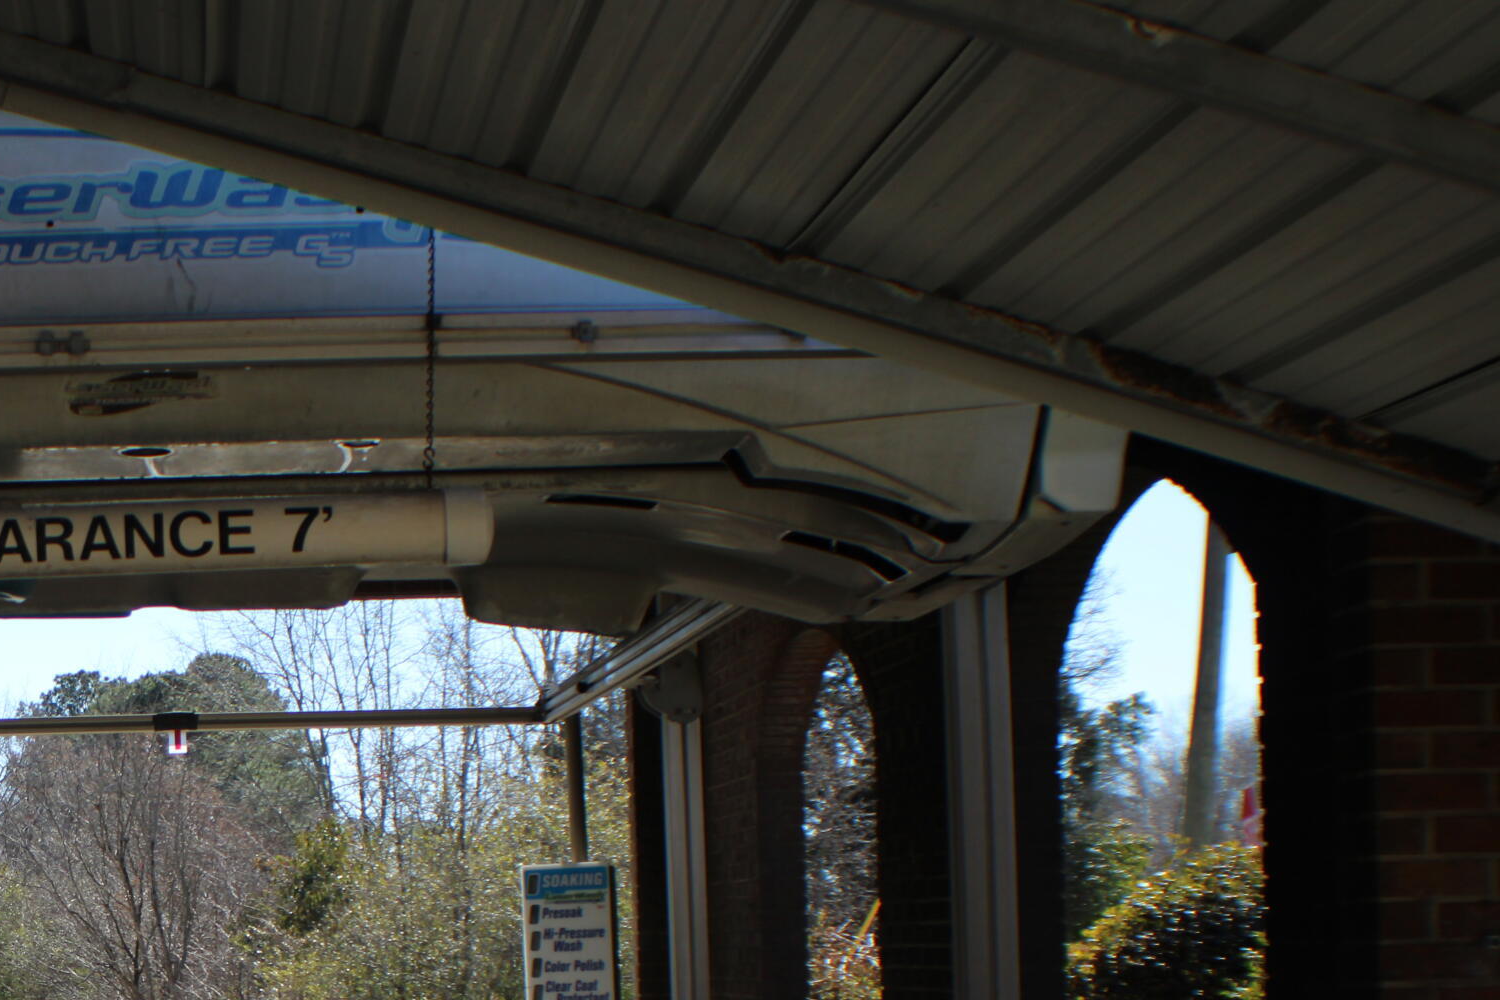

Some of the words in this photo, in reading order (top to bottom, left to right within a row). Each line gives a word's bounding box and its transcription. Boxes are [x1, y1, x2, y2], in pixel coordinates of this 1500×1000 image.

[126, 234, 275, 262] FREE
[542, 872, 604, 888] SOAKING
[542, 906, 583, 920] Presoak
[543, 927, 606, 940] Hi-Pressure
[553, 940, 583, 952] Wash
[544, 960, 571, 973] Color
[573, 959, 605, 972] Polish
[545, 980, 572, 993] Clear
[575, 979, 598, 992] Coat
